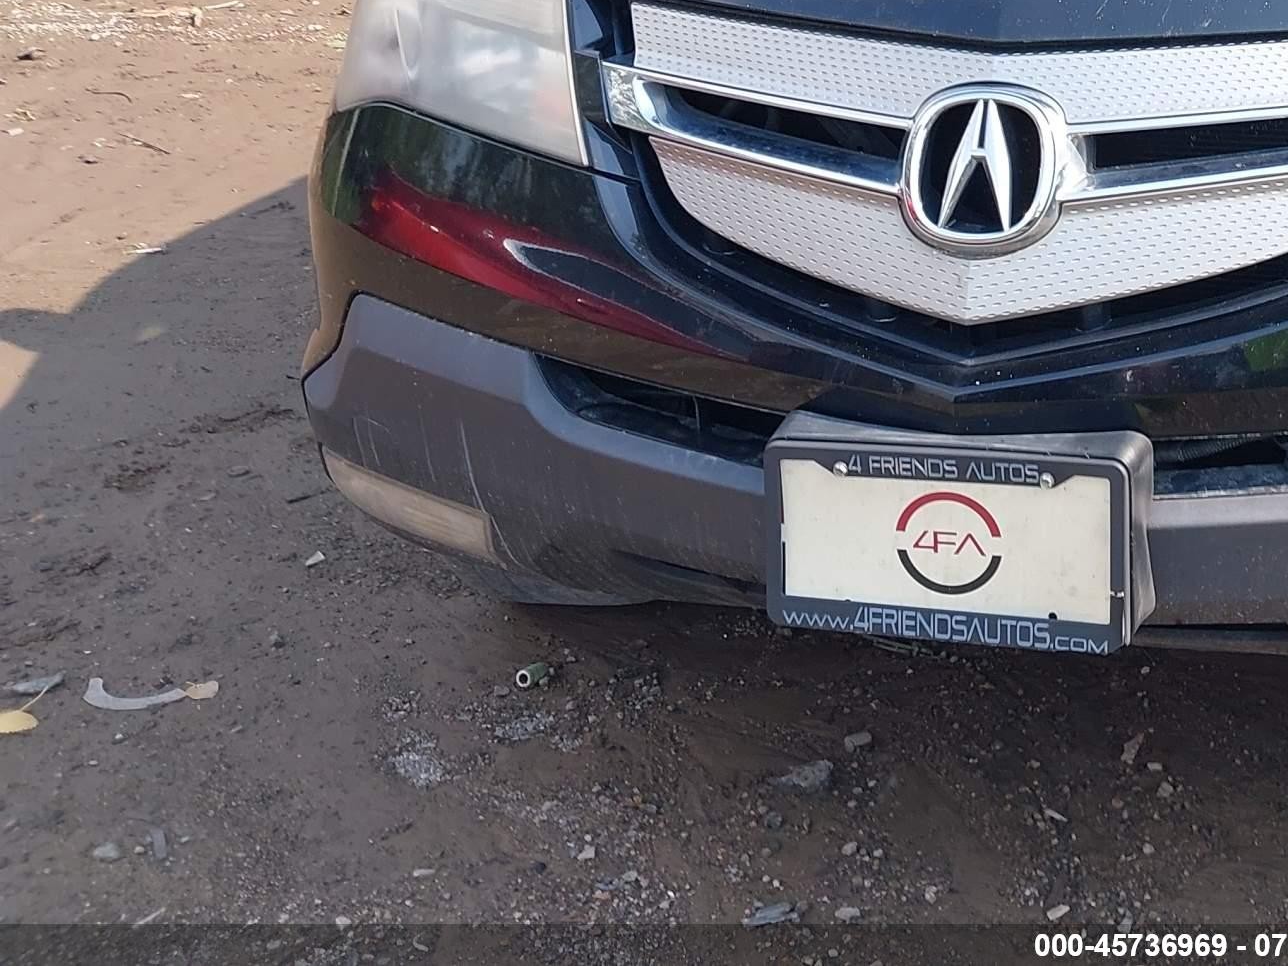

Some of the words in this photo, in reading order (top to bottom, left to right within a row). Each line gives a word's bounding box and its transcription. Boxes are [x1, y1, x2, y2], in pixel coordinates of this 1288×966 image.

[848, 454, 862, 474] 4
[868, 456, 959, 480] FRIENDS
[965, 461, 1040, 485] AUTOS
